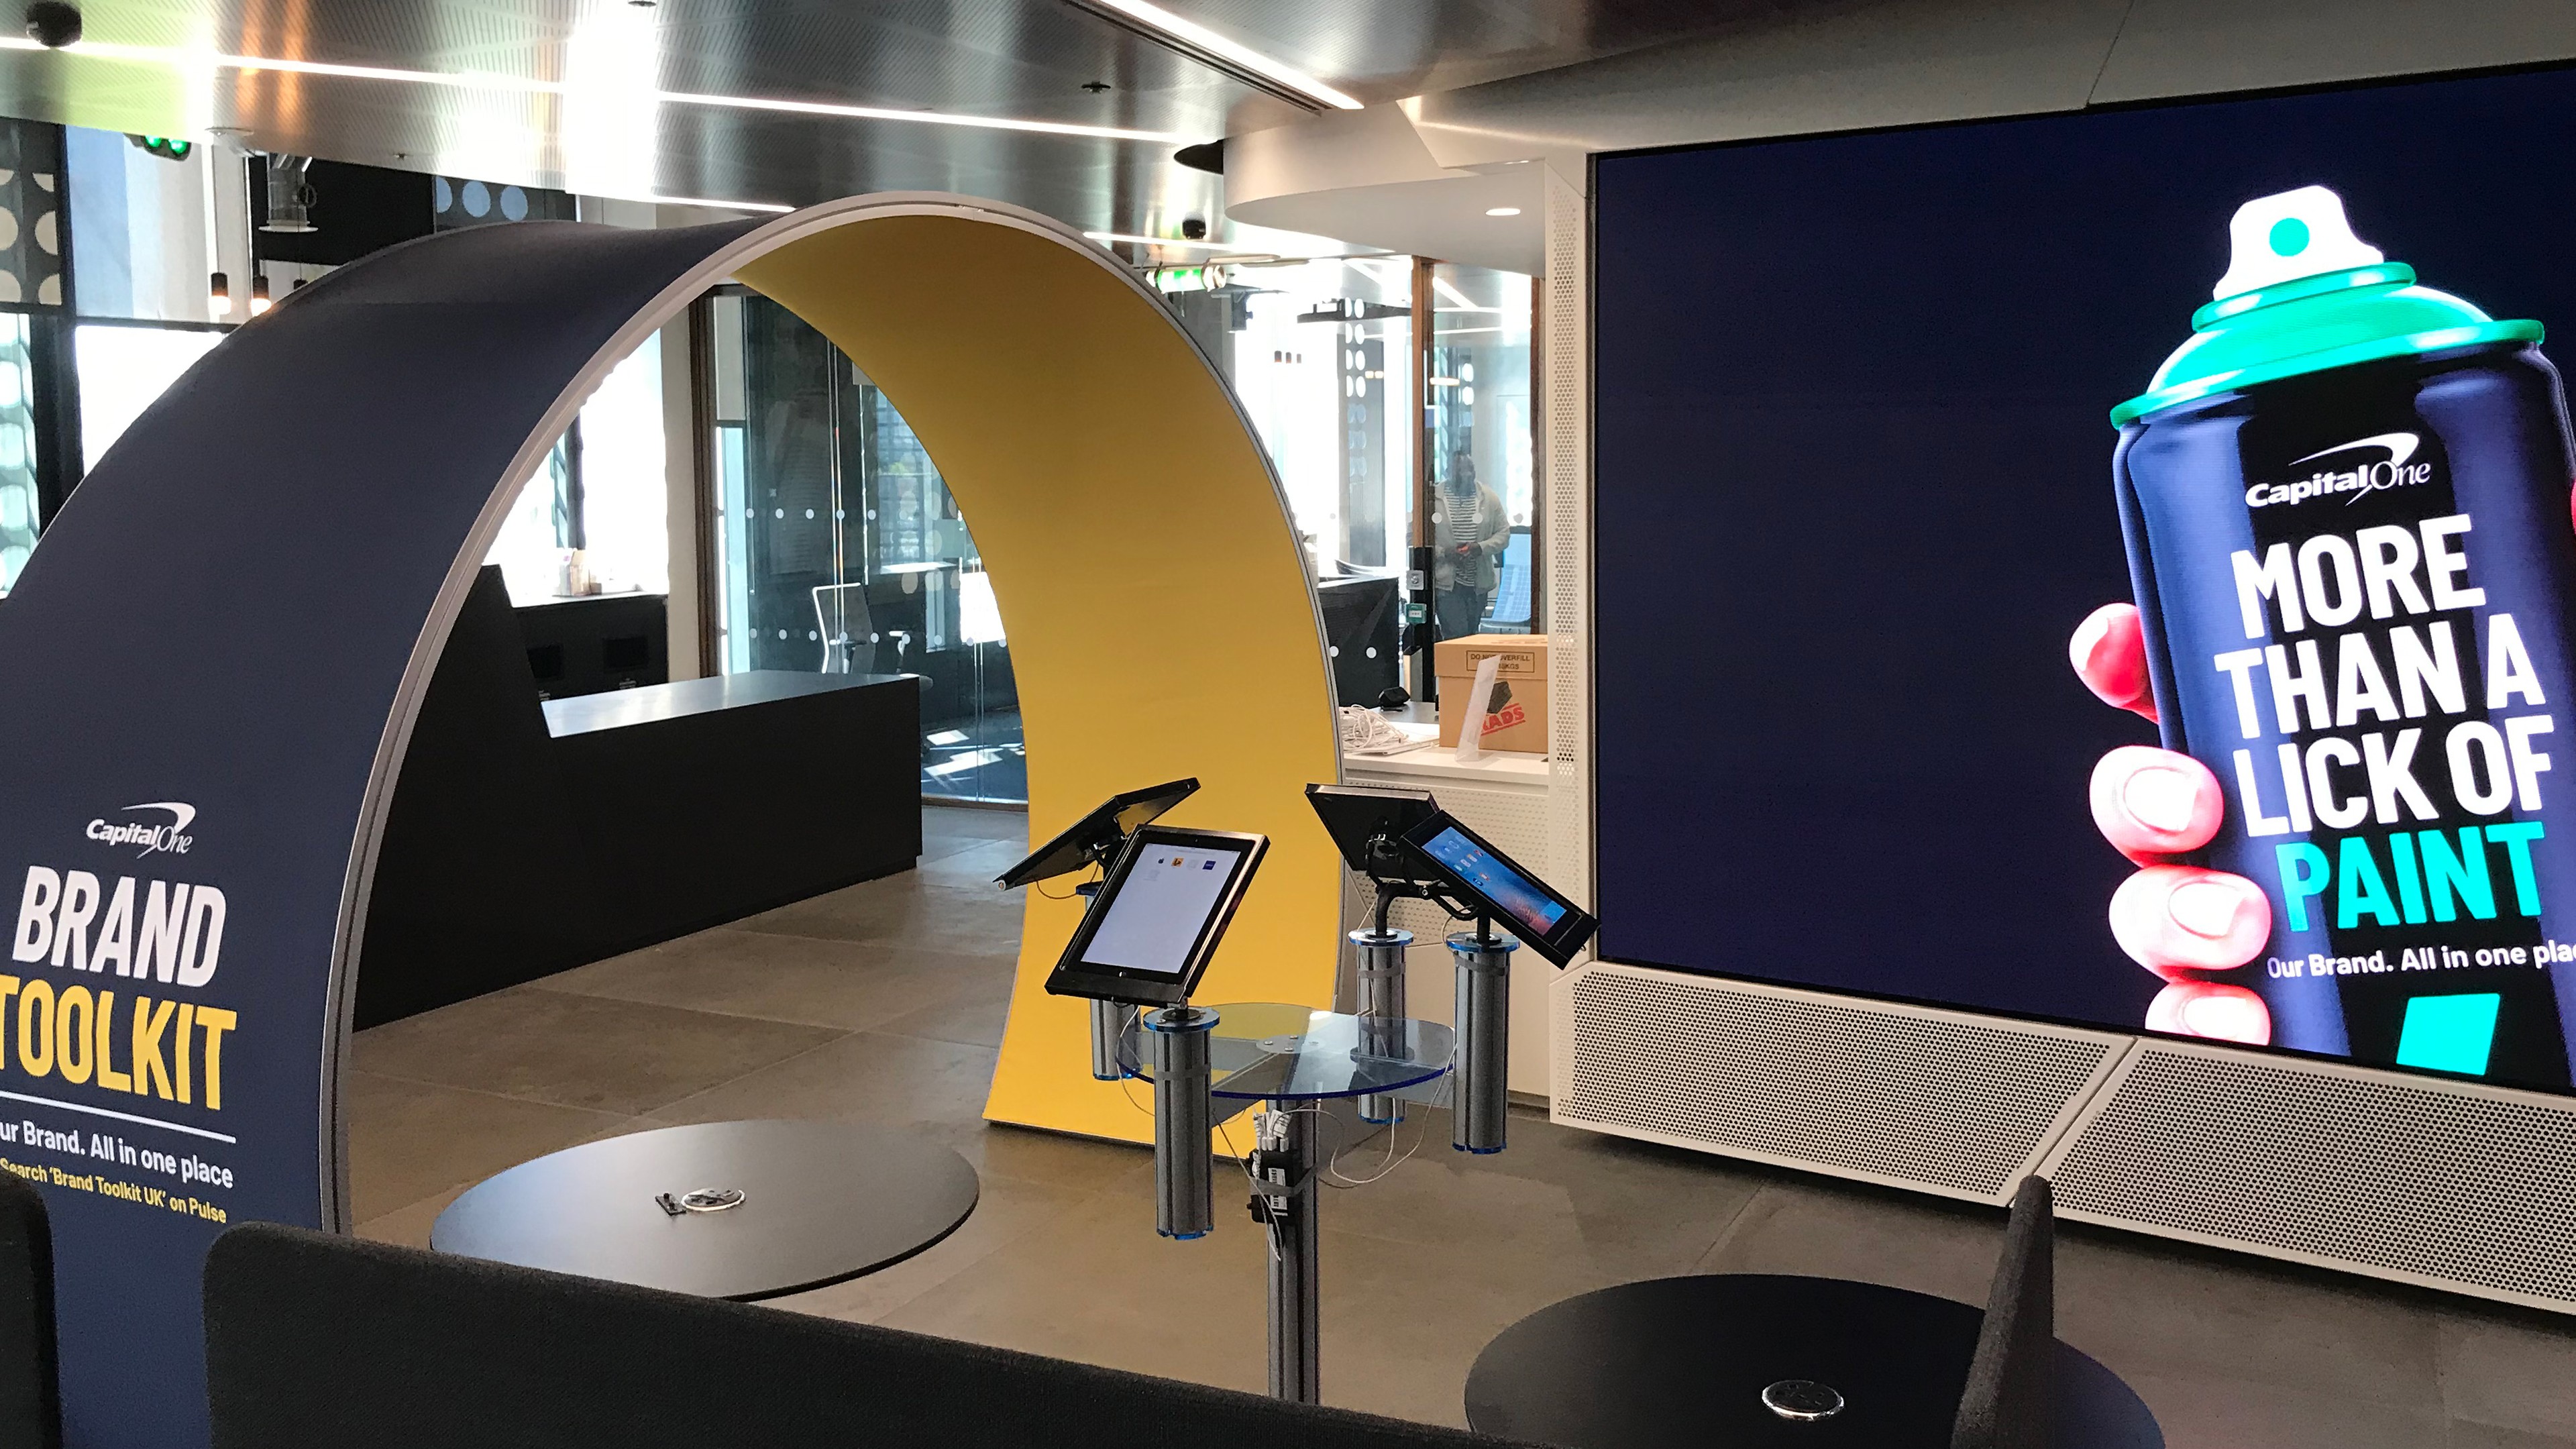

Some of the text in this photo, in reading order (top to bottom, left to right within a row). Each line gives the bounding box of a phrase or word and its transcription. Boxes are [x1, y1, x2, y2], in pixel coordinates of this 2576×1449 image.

[2231, 513, 2486, 639] MORE
[2214, 613, 2546, 739] THAN A
[2233, 714, 2555, 837] LICK OF
[12, 865, 226, 987] BRAND
[2275, 821, 2544, 932] PAINT
[2267, 939, 2576, 979] Our Brand. All in one pla
[0, 1120, 233, 1189] ur Brand. All in one place
[95, 1175, 142, 1203] Toolkit
[169, 1197, 187, 1214] on
[189, 1197, 227, 1223] Pulse
